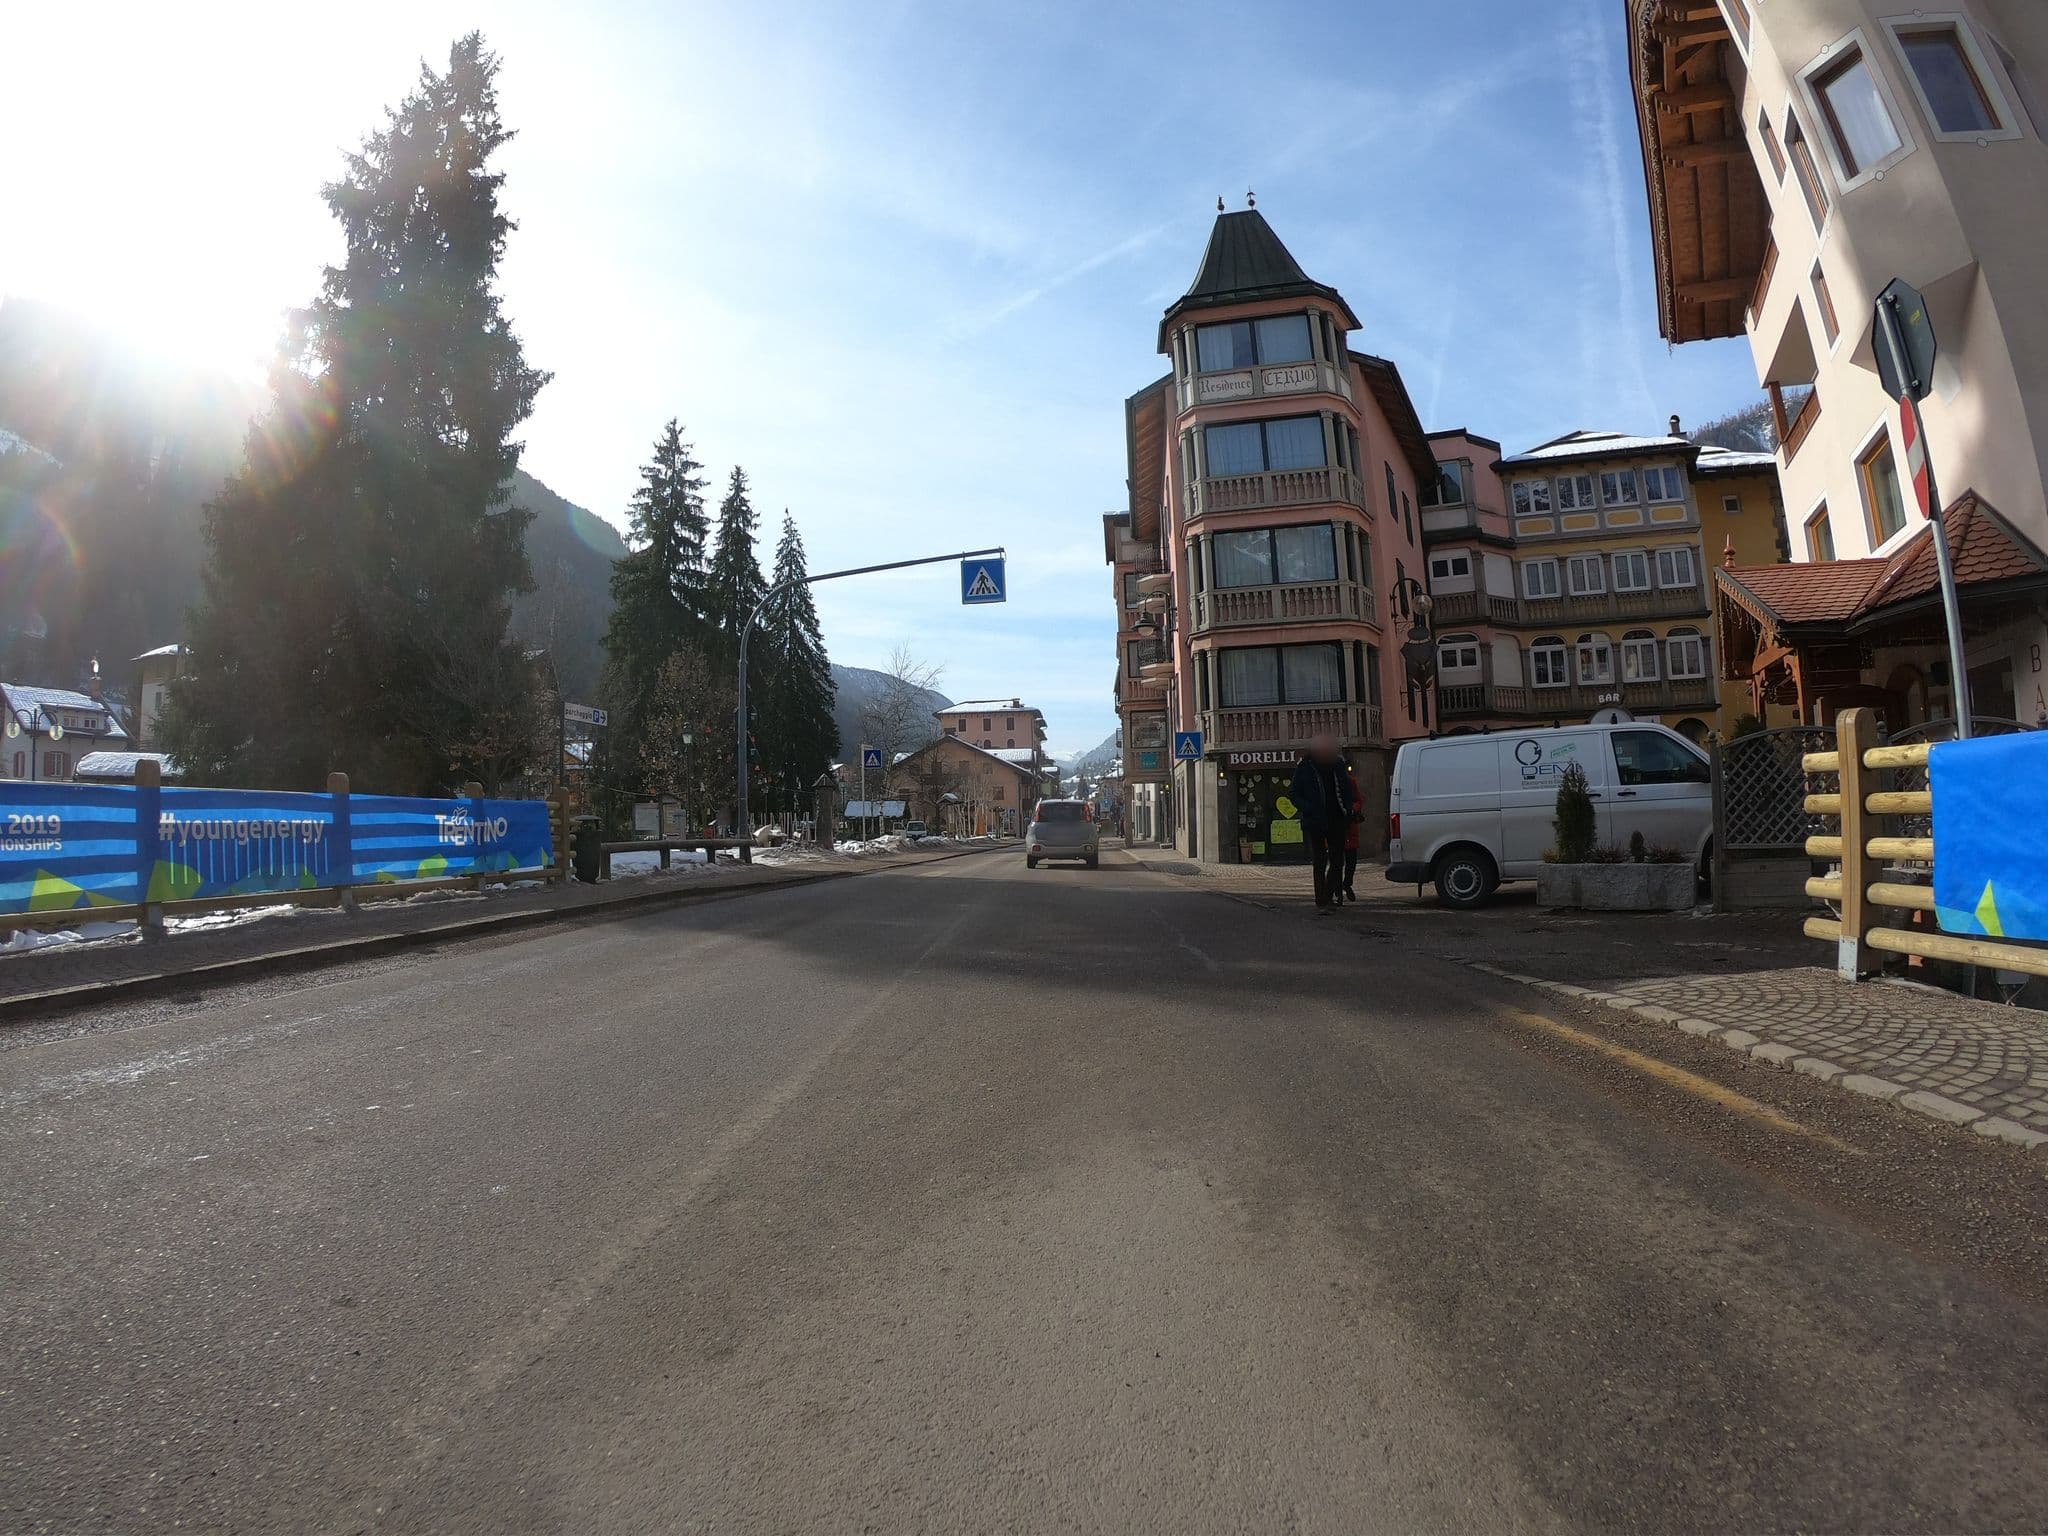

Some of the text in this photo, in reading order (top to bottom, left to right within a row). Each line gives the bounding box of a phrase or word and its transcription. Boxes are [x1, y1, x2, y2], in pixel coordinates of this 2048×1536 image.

[1201, 379, 1251, 394] Residence
[1598, 692, 1620, 703] BAR
[1230, 750, 1296, 765] BORELLI
[8, 814, 61, 835] 2019
[159, 812, 325, 847] #youngenergy
[435, 814, 508, 846] TRENTINO
